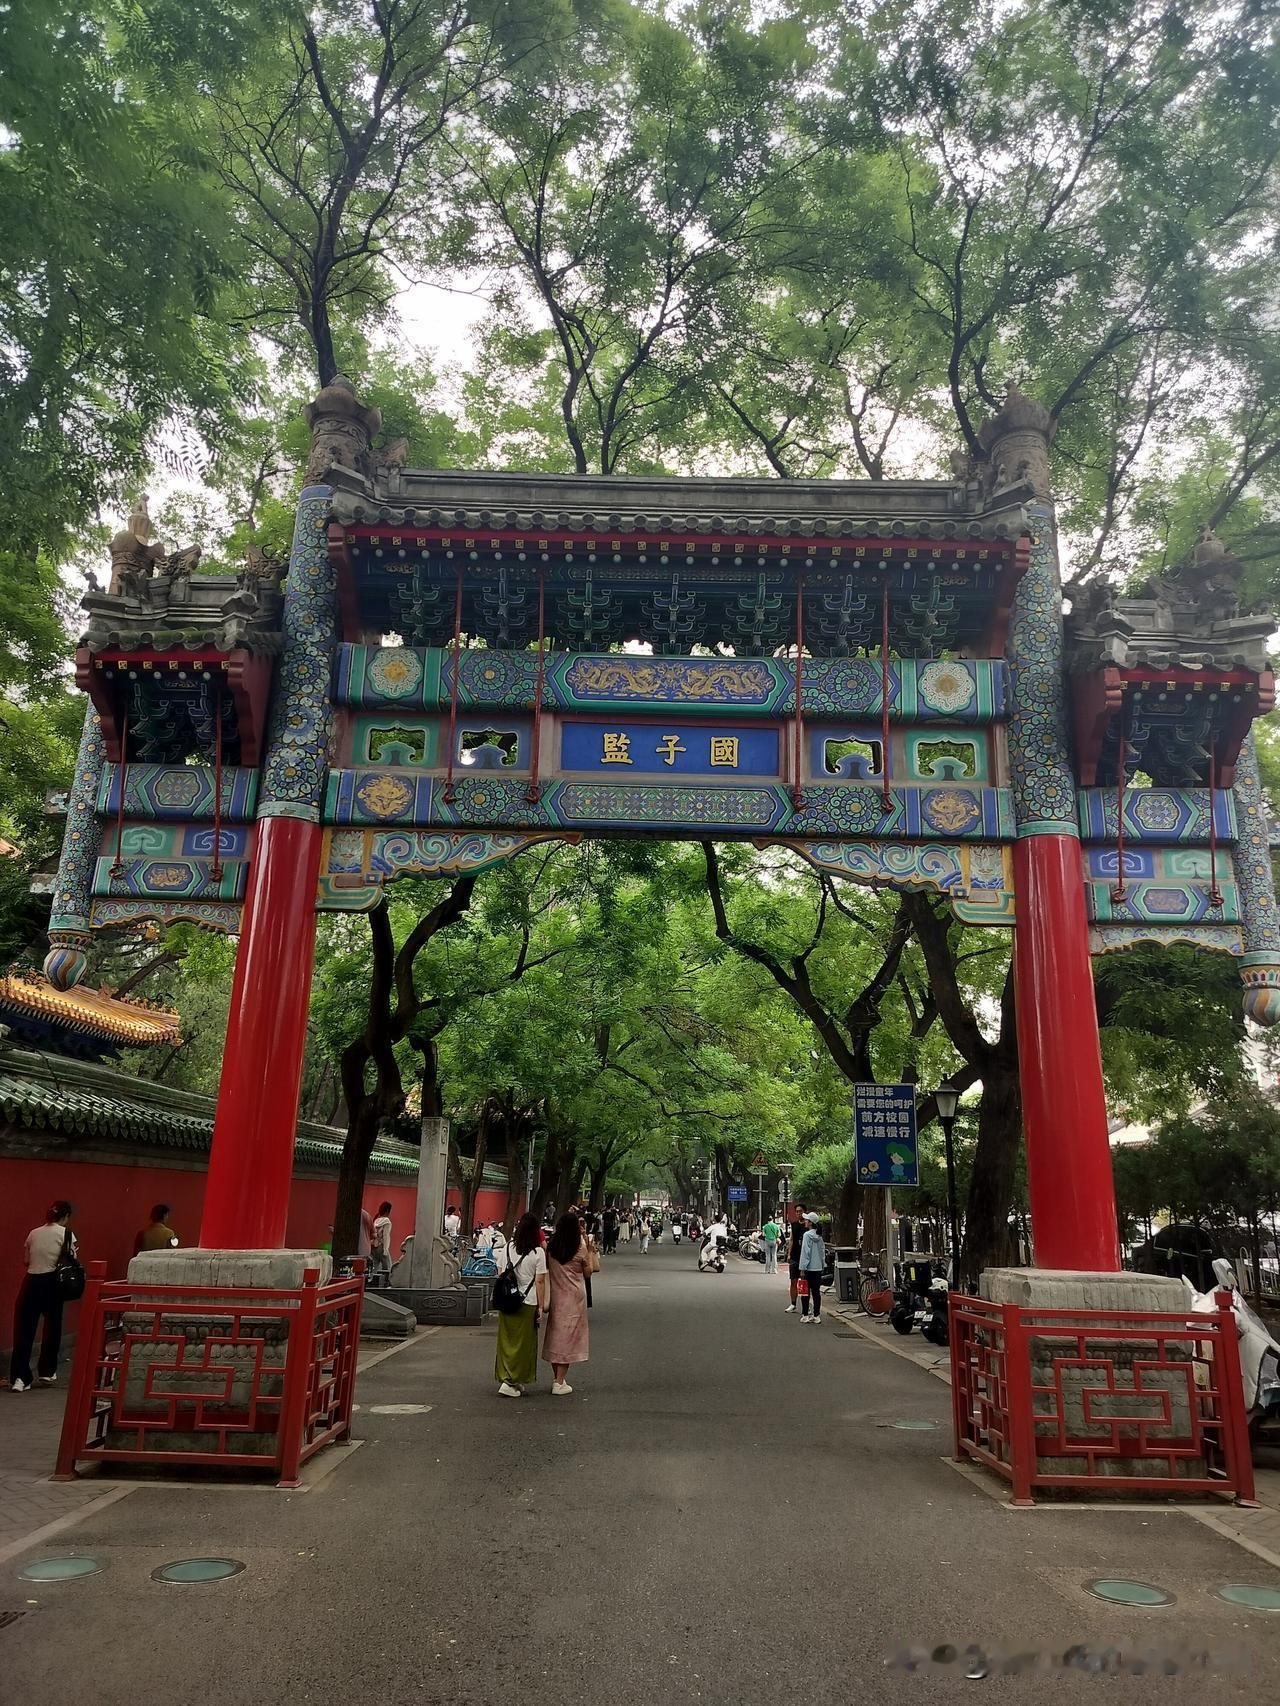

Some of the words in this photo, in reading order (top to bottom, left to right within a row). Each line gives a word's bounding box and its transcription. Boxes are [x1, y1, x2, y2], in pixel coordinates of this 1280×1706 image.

[856, 1086, 893, 1097] 烂漫童年
[857, 1098, 913, 1109] 需要您的呵护
[861, 1111, 909, 1123] 前方校园
[862, 1126, 910, 1137] 减速慢行
